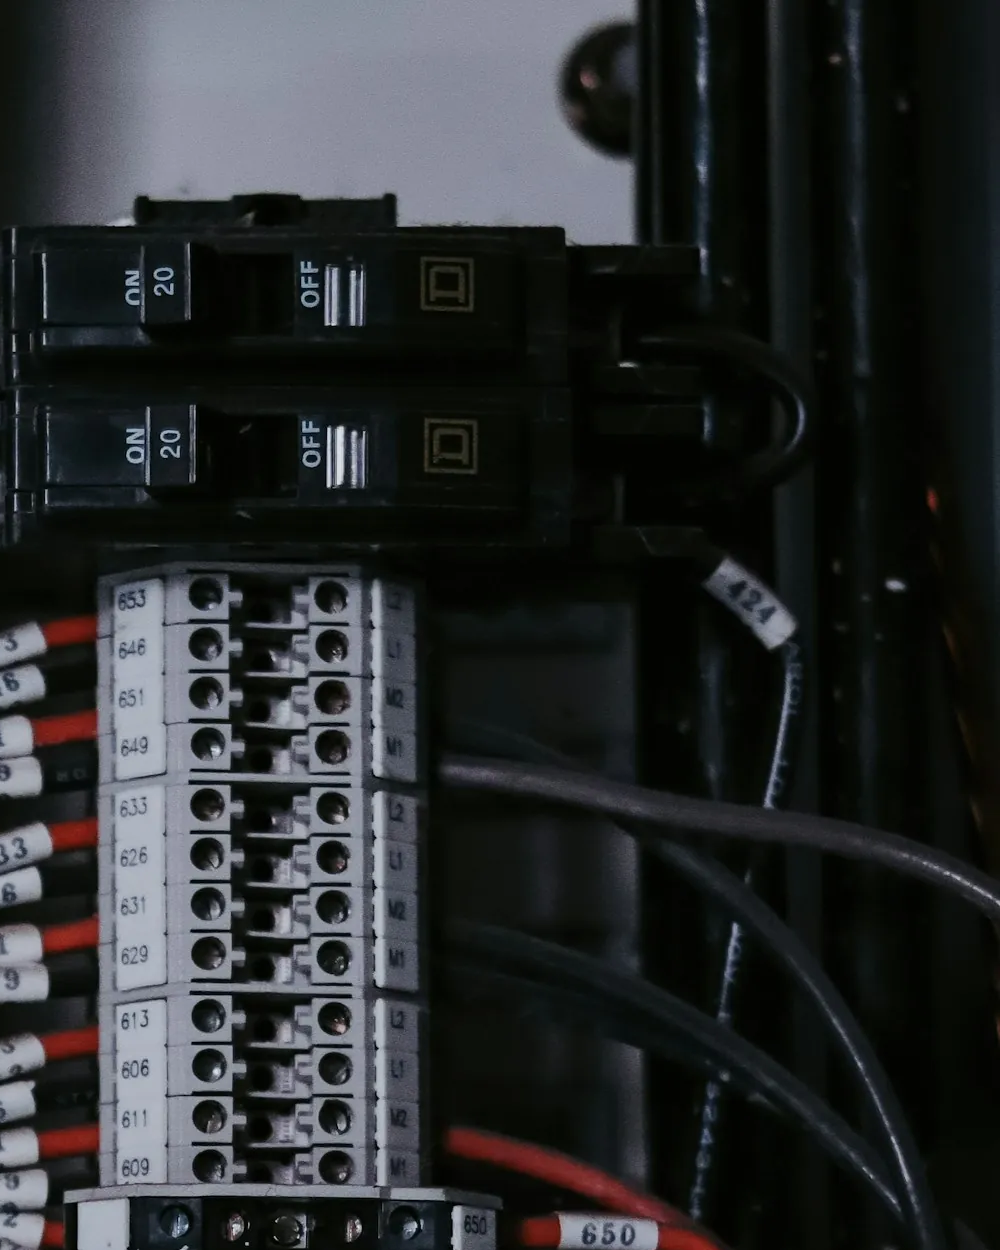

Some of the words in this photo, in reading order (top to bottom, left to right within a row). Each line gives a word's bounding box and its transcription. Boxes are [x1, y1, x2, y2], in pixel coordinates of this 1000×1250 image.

[124, 269, 142, 306] ON
[153, 266, 175, 297] 20
[300, 260, 321, 308] OFF
[126, 428, 146, 464] ON
[159, 429, 182, 459] 20
[301, 420, 322, 468] OFF
[117, 588, 147, 611] 653
[118, 638, 146, 660] 646
[118, 691, 145, 709] 651
[120, 737, 149, 758] 649
[119, 797, 147, 817] 633
[120, 847, 148, 867] 626
[120, 896, 146, 915] 631
[121, 945, 149, 965] 629
[121, 1009, 149, 1030] 613
[121, 1059, 149, 1079] 606
[121, 1109, 147, 1129] 611
[121, 1157, 149, 1177] 609
[463, 1216, 488, 1236] 650
[581, 1223, 636, 1246] 650
